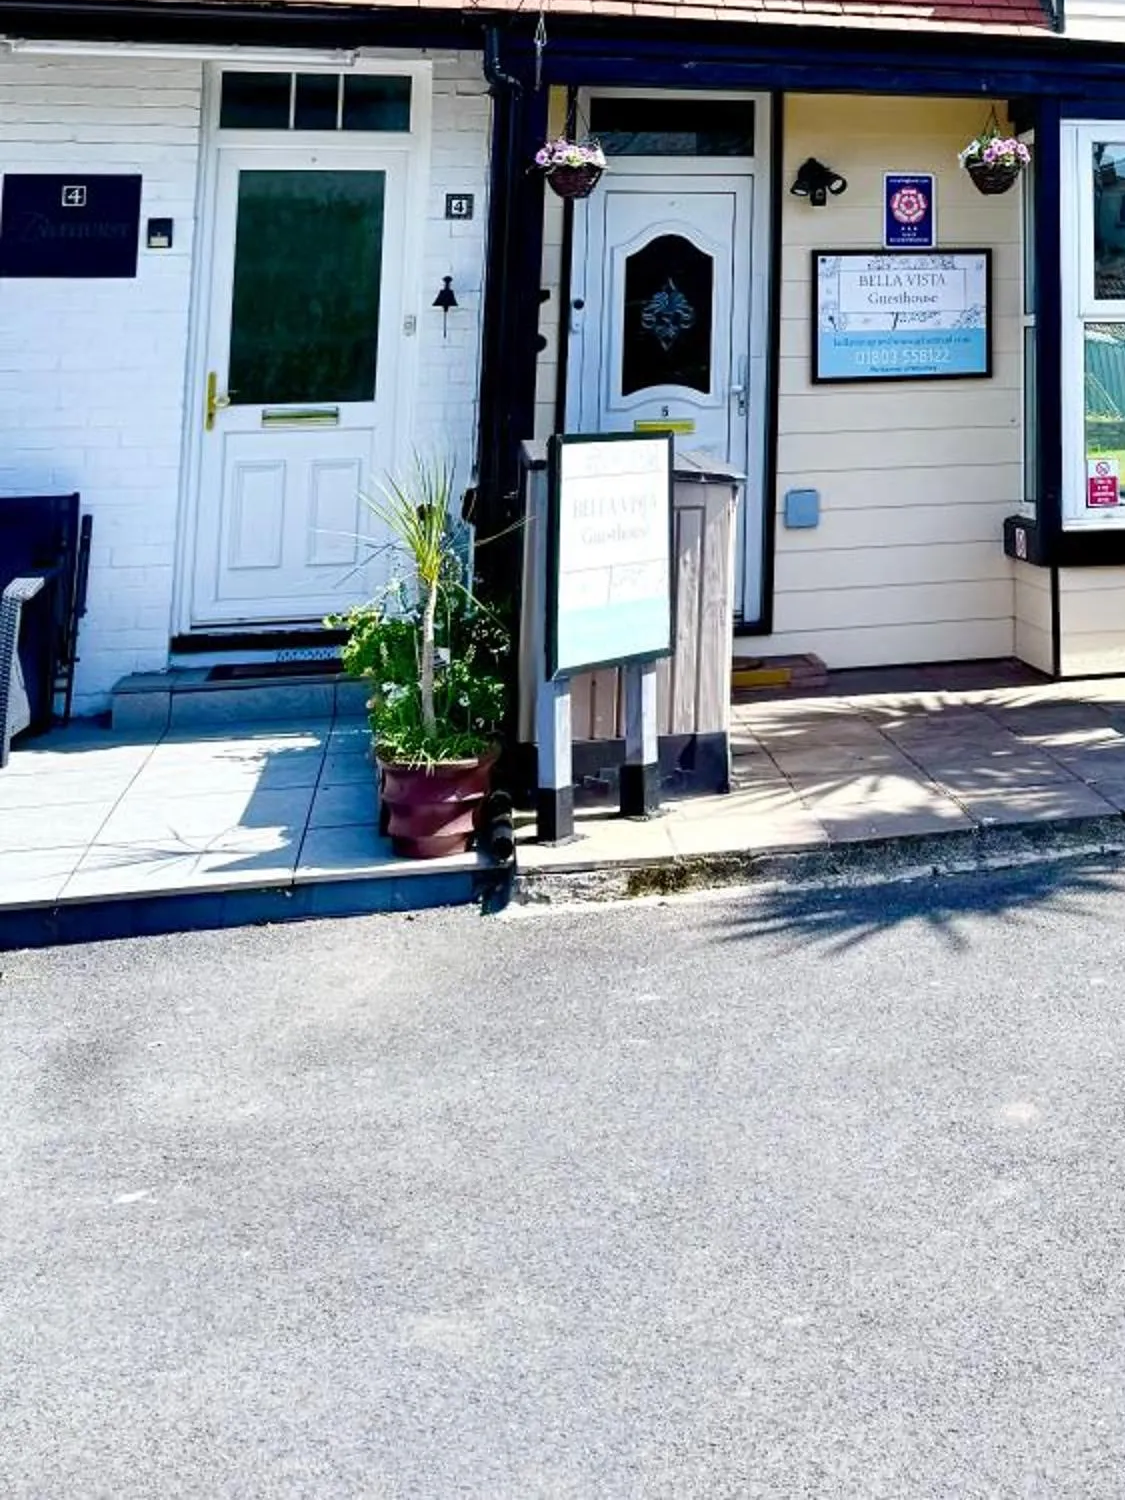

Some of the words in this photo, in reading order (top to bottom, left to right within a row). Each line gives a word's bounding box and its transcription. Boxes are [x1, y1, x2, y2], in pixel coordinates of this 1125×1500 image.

[67, 189, 82, 204] 4
[453, 201, 465, 213] 4
[858, 274, 903, 288] BELLA
[905, 273, 947, 287] VISTA
[867, 291, 939, 305] Guesthouse
[855, 347, 898, 366] 01803
